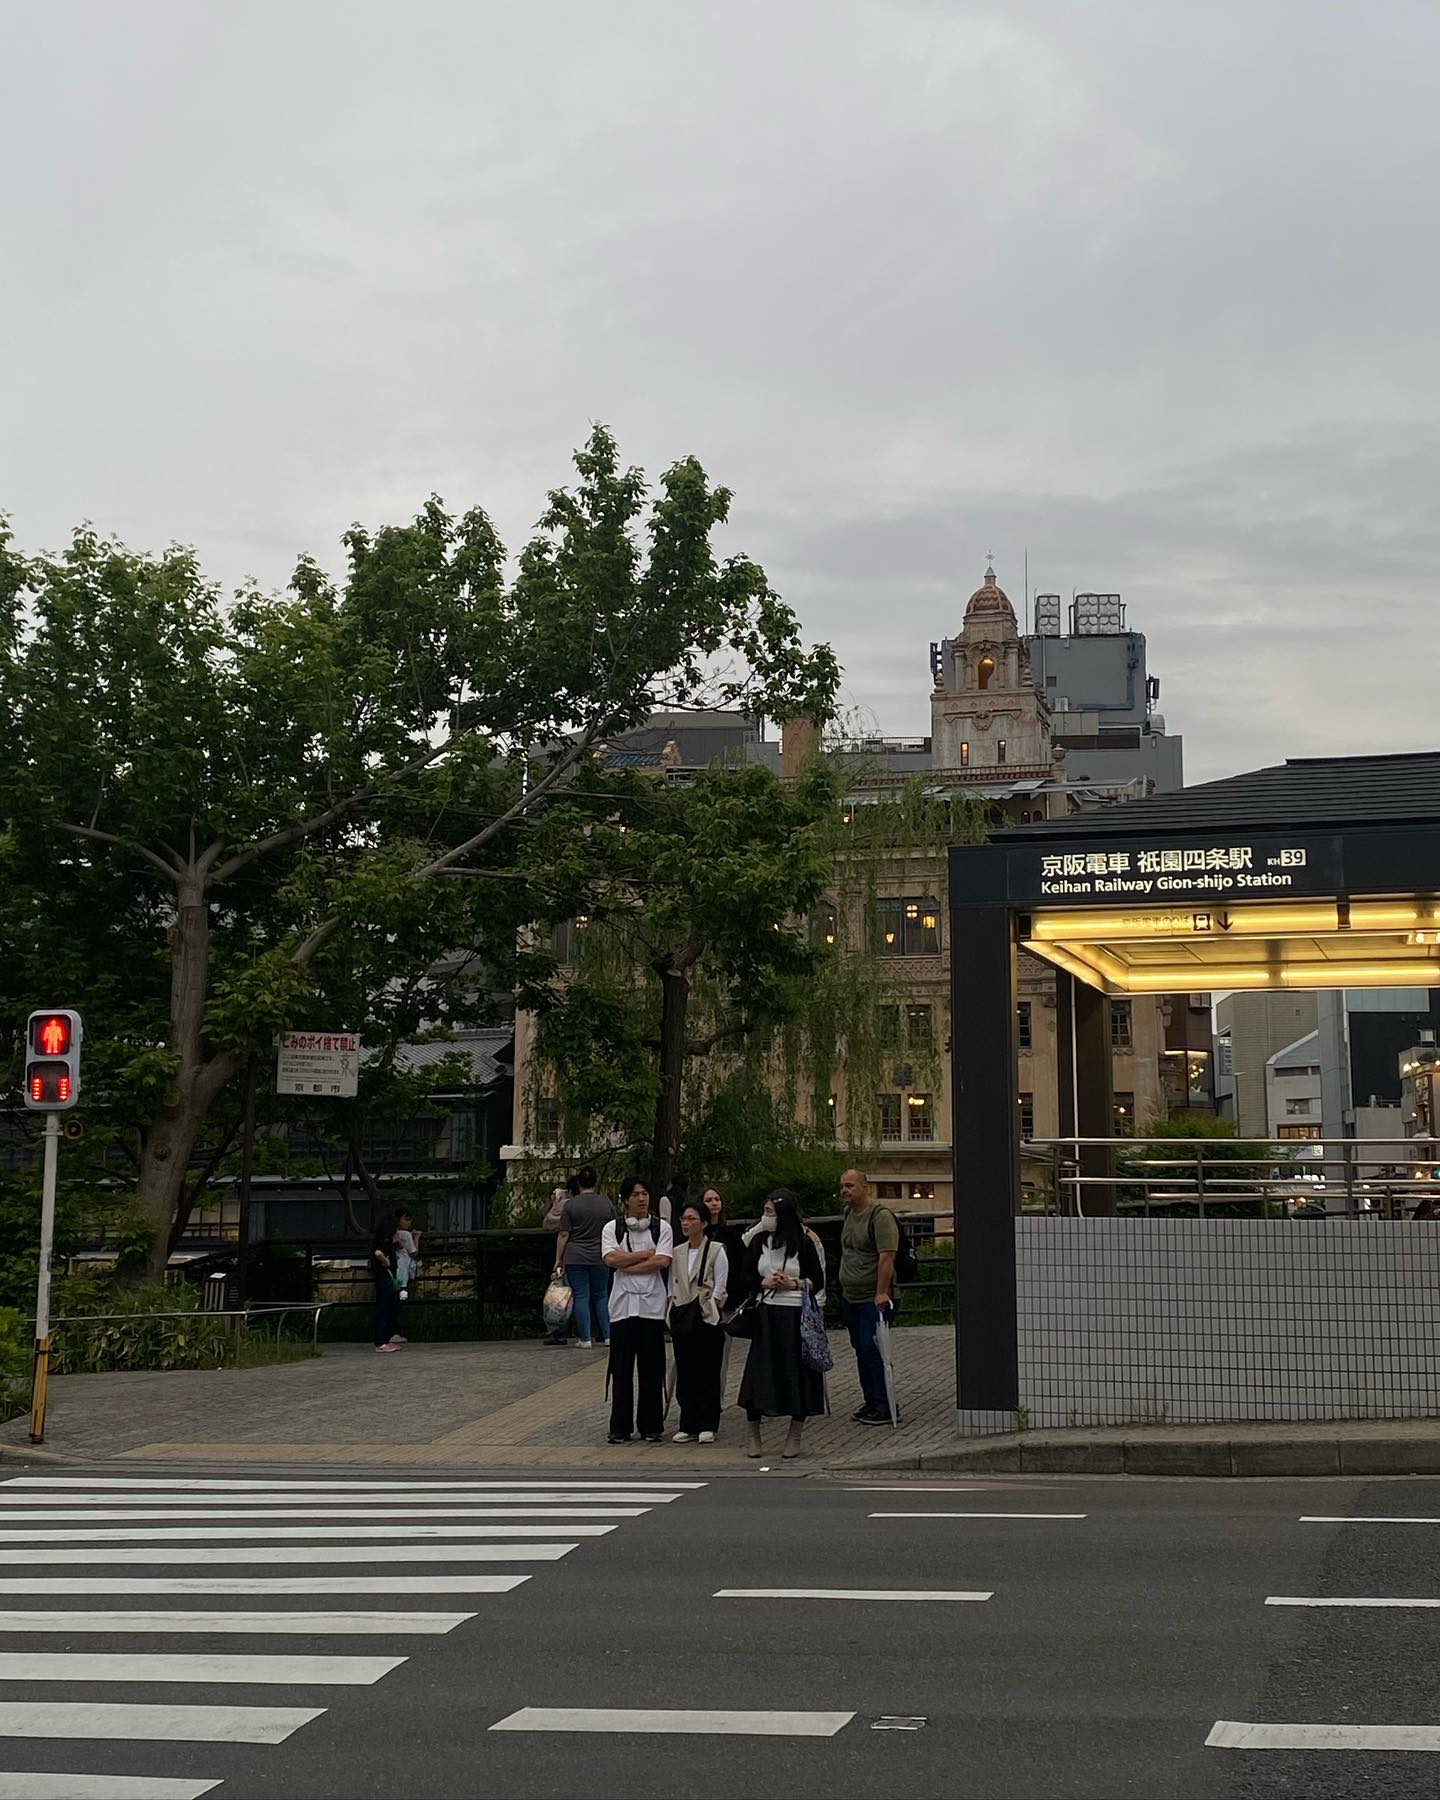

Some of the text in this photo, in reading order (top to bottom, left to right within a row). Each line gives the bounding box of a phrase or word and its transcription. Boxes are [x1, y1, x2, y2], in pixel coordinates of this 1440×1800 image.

[1041, 846, 1253, 876] 京阪電車 祇園四条駅
[1267, 850, 1304, 866] KH 39
[1041, 873, 1292, 894] Keihan Railway Gion-shijo Station
